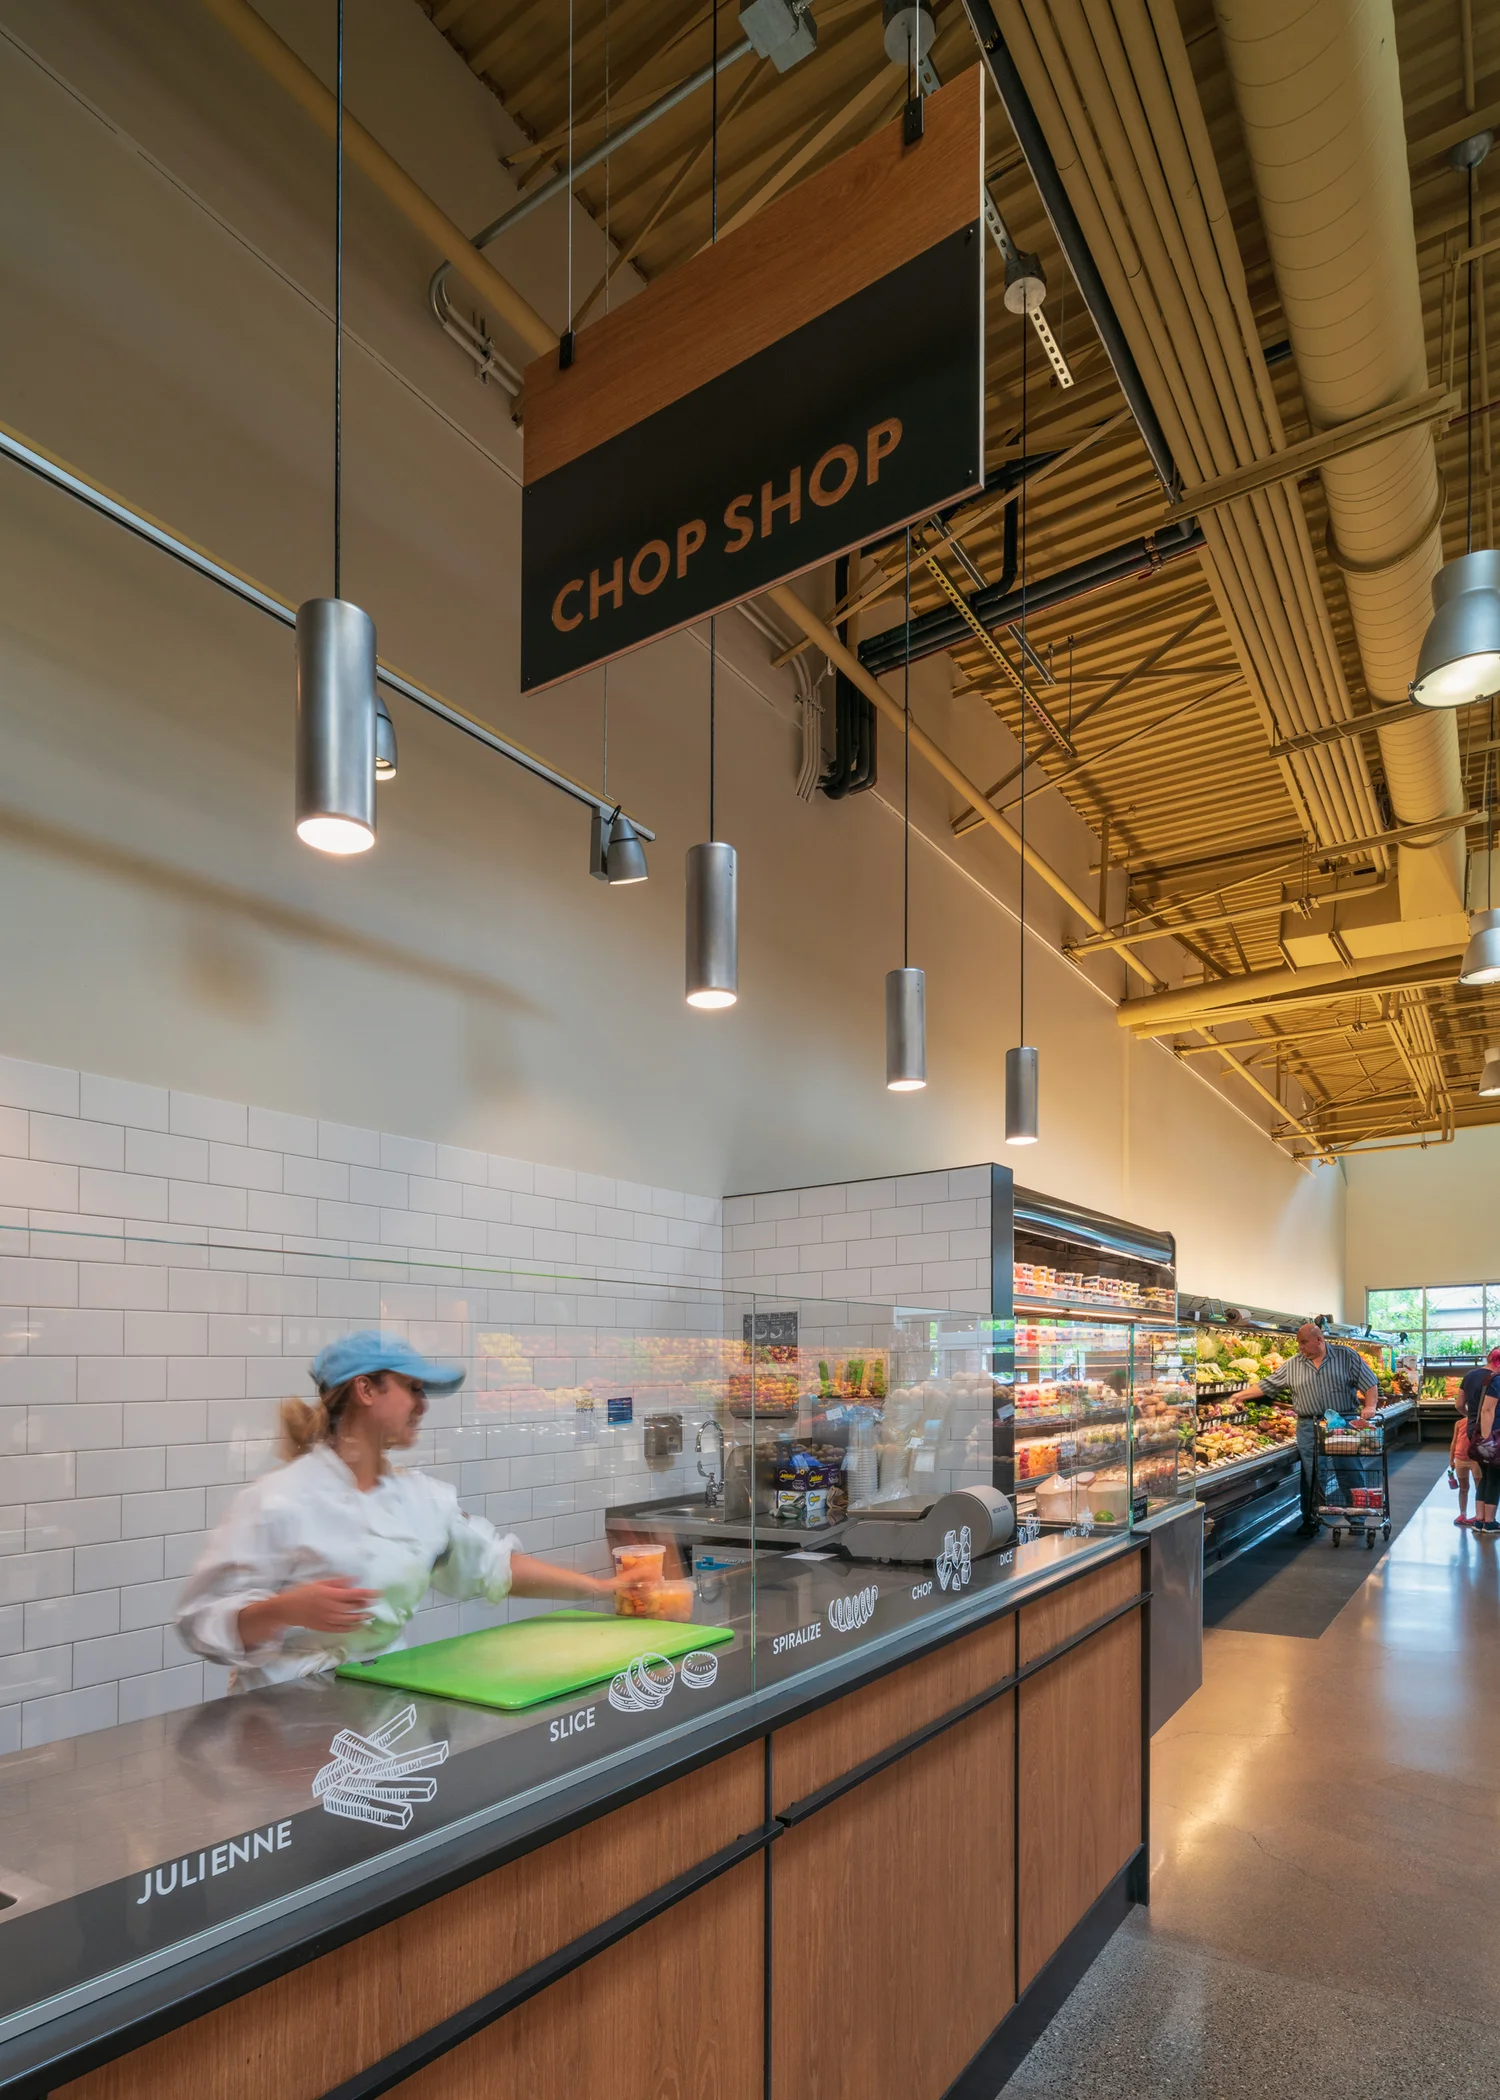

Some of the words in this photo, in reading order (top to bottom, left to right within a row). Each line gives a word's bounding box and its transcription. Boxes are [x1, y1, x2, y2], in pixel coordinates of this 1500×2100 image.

[552, 518, 707, 633] CHOP
[723, 417, 903, 554] SHOP
[1063, 1526, 1077, 1539] MINCE
[999, 1550, 1013, 1566] DICE
[911, 1581, 933, 1600] CHOP
[772, 1622, 822, 1655] SPIRALIZE
[550, 1706, 596, 1743] SLICE
[136, 1820, 293, 1905] JULIENNE
